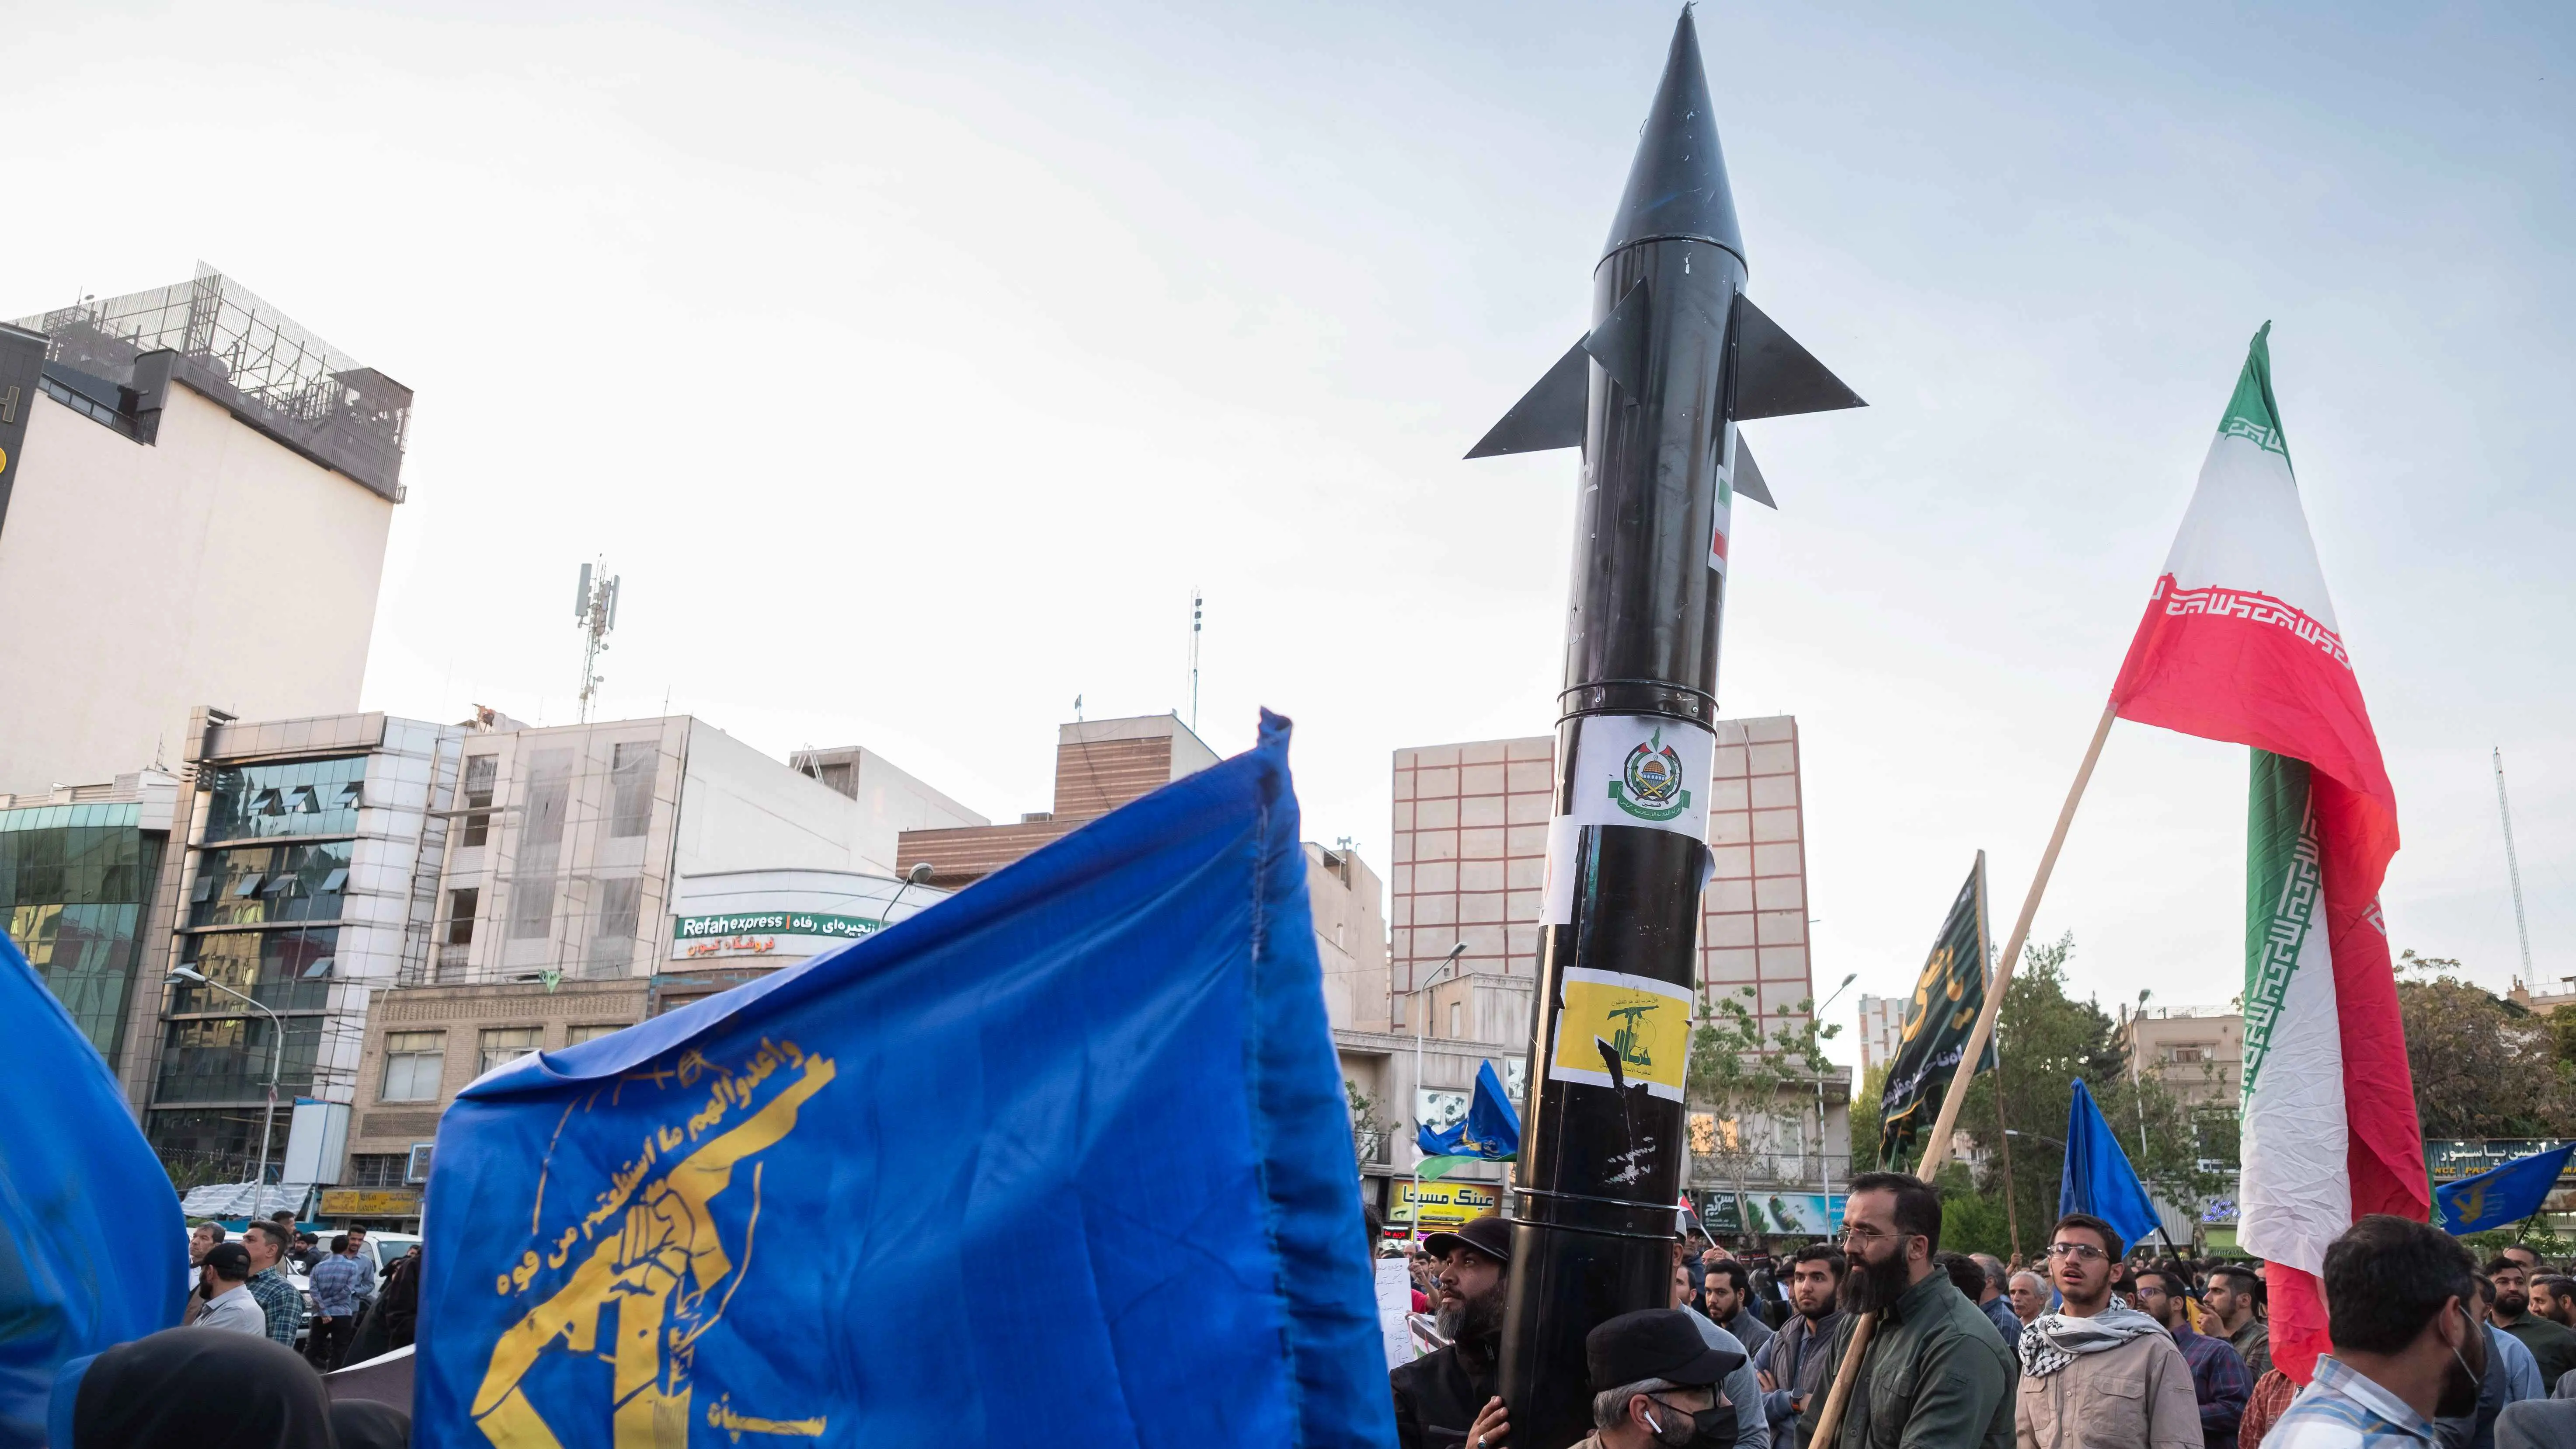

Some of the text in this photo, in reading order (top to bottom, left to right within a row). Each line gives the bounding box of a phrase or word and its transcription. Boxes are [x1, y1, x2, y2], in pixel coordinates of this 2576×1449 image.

[683, 916, 783, 936] Refah express
[793, 916, 817, 932] رفاه
[724, 935, 775, 952] فروشگاه
[658, 1125, 684, 1153] ما
[2440, 1142, 2506, 1166] پاستور
[1454, 1190, 1493, 1211] عینک
[548, 1226, 578, 1269] من
